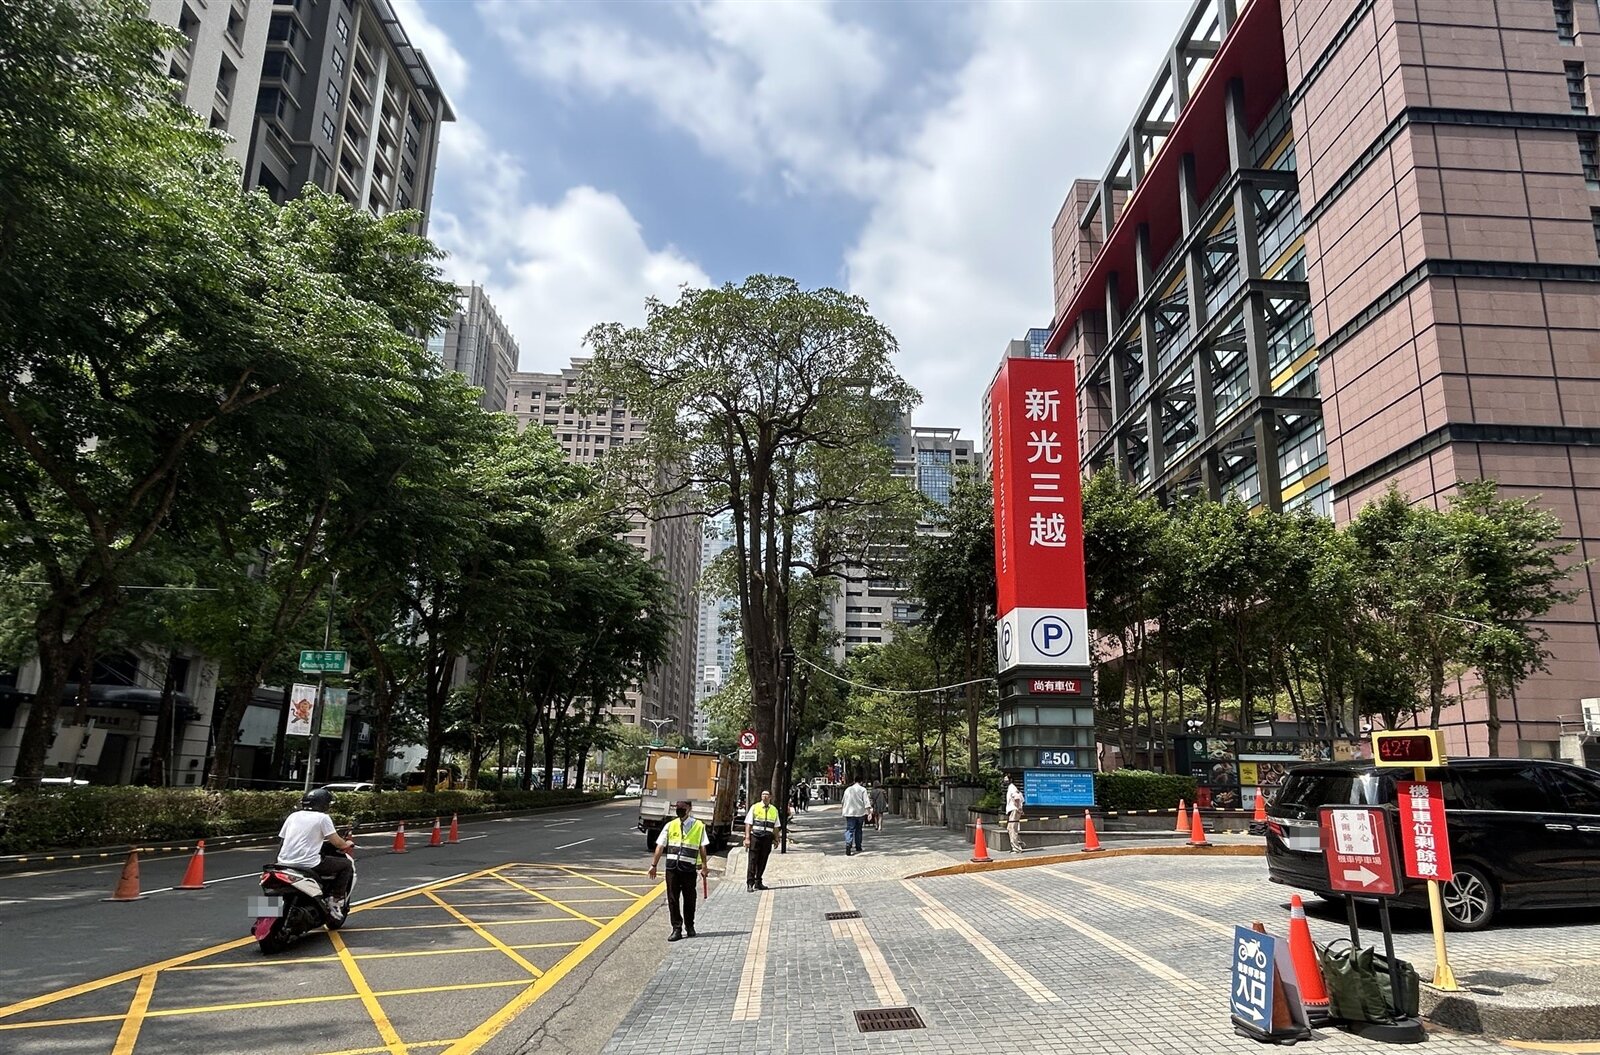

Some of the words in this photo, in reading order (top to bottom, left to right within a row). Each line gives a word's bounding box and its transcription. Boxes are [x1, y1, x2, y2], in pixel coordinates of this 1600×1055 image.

[1024, 388, 1067, 547] 新光三越
[1043, 623, 1063, 649] P
[1033, 680, 1076, 692] 尚有車位
[1053, 752, 1070, 765] 50
[1381, 740, 1411, 756] 427
[1409, 784, 1439, 877] 機車車位剩餘數
[1236, 973, 1266, 1010] 入口
